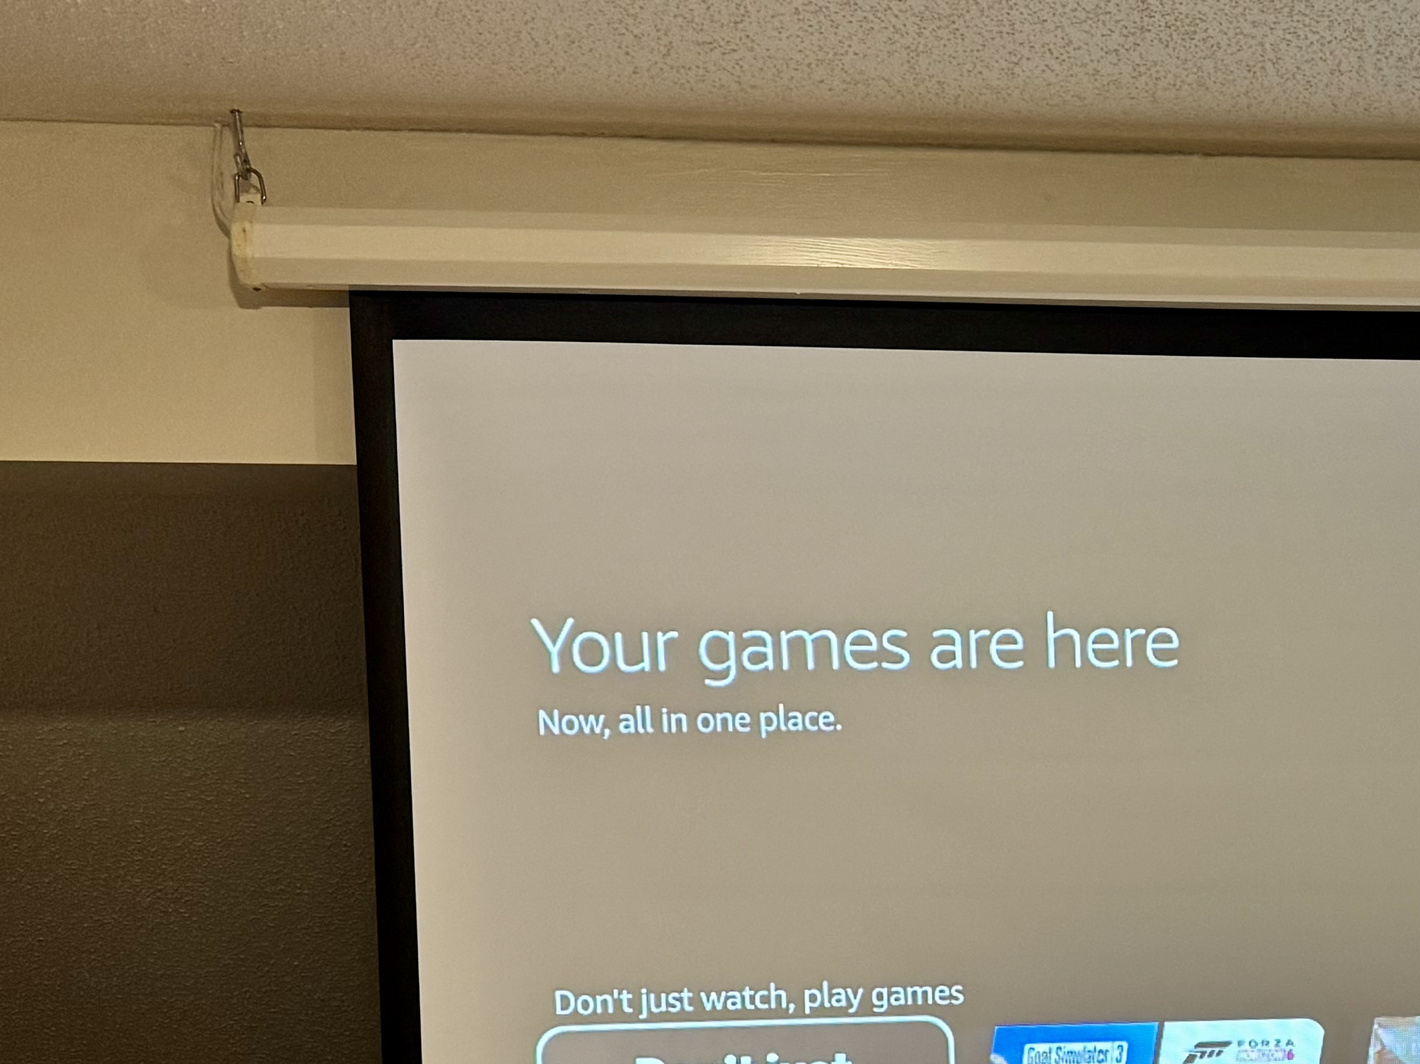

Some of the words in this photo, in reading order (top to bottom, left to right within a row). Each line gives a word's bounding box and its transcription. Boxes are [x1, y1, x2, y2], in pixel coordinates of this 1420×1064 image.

[530, 616, 678, 673] Your
[699, 626, 911, 686] games
[930, 626, 1025, 669] are
[1046, 611, 1180, 668] here
[538, 707, 610, 738] Now,
[618, 705, 654, 735] all
[661, 707, 688, 733] in
[697, 711, 751, 733] one
[759, 704, 843, 738] place.
[554, 989, 633, 1015] Don't
[639, 988, 693, 1018] just
[700, 983, 796, 1013] watch,
[804, 981, 864, 1013] play
[872, 984, 965, 1012] games
[1115, 1044, 1124, 1064] 3
